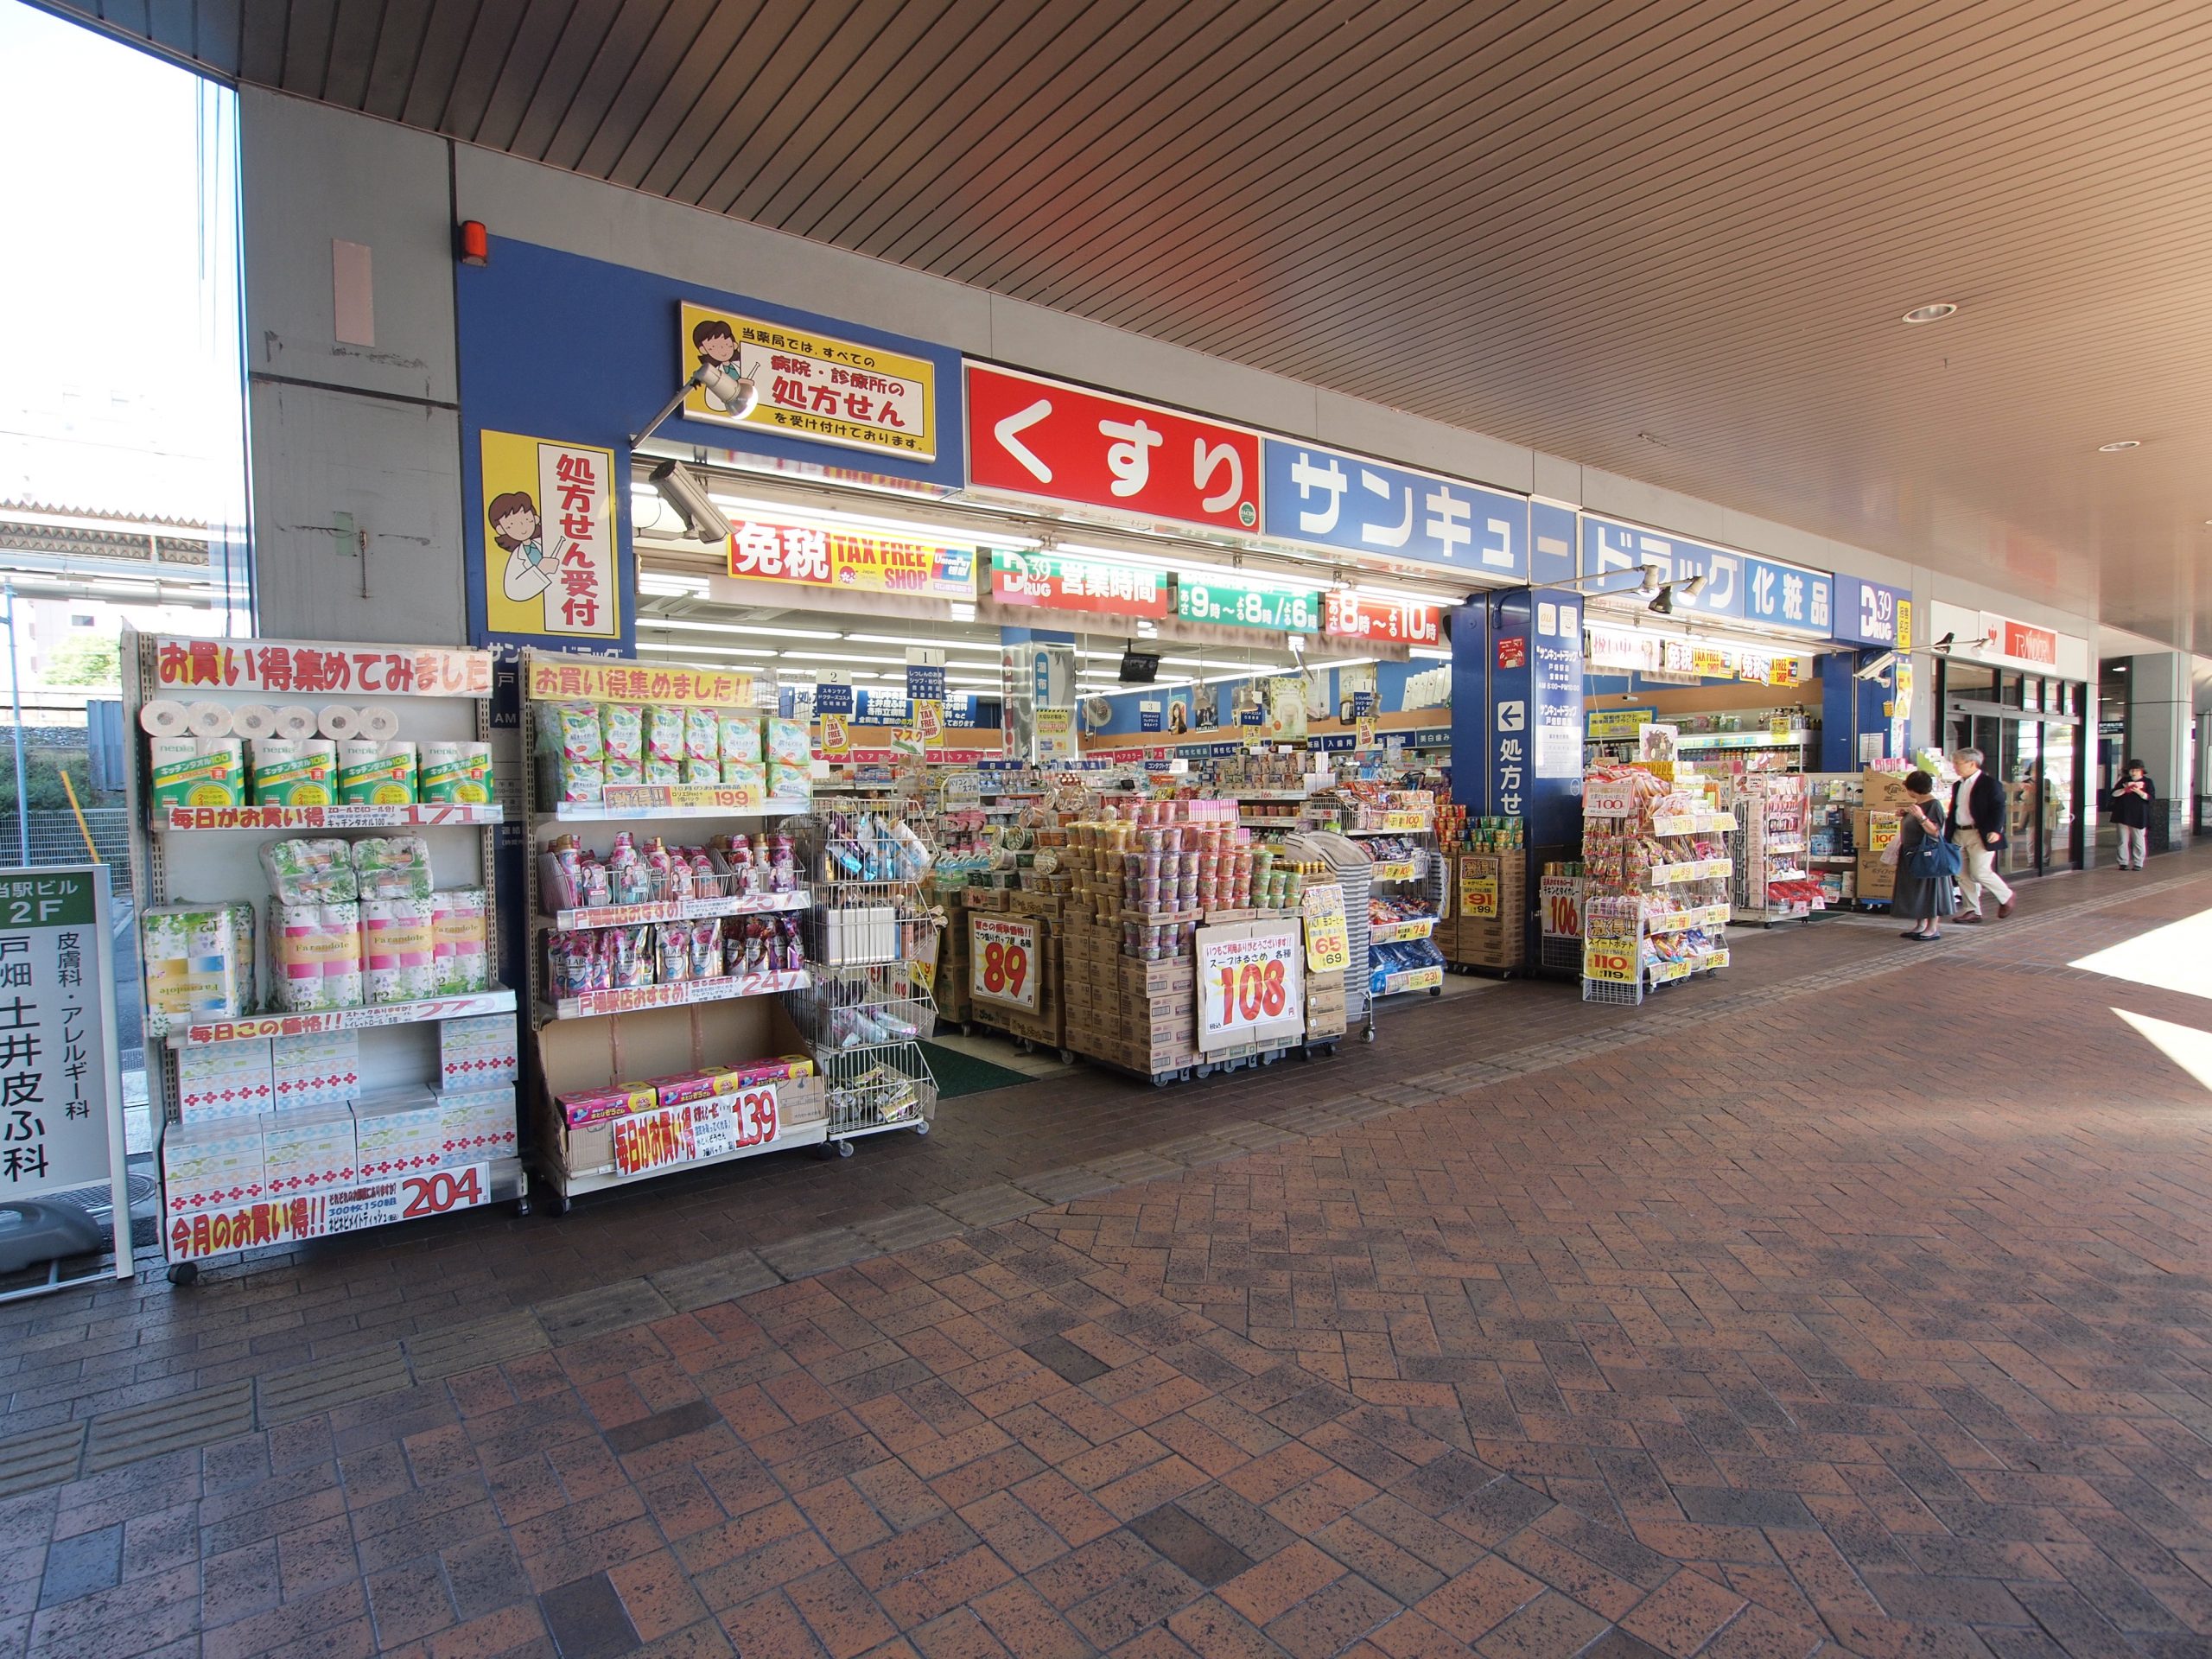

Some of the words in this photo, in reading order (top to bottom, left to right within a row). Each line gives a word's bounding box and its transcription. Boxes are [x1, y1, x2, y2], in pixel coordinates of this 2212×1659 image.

[771, 355, 906, 397] 病院・診療所の
[772, 376, 906, 428] 処方せん
[775, 413, 923, 452] を受け付けております。
[995, 399, 1243, 512] くすり
[556, 454, 599, 626] 処方せん受付
[734, 521, 830, 579] 免税
[833, 536, 876, 564] TAX
[880, 541, 927, 568] FREE
[884, 568, 928, 590] SHOP
[1060, 563, 1157, 603] 営業時間
[1752, 566, 1828, 626] 化粧品
[1877, 590, 1892, 622] 39
[160, 641, 488, 692] お買い得集めてみました
[923, 652, 927, 663] 1
[1668, 644, 1693, 671] 免税
[1694, 648, 1706, 661] TAX
[1706, 650, 1719, 663] FREE
[830, 672, 837, 683] 2
[1707, 663, 1719, 674] SHOP
[536, 666, 753, 703] お買い得集めました!!
[495, 714, 517, 723] AM
[920, 709, 933, 720] TAX
[920, 719, 935, 728] FREE
[828, 731, 841, 740] FREE
[828, 738, 843, 747] SHOP
[893, 728, 924, 743] マスク
[1179, 747, 1208, 756] 男性化粧品
[160, 754, 229, 776] キッチンタオル100
[264, 755, 327, 776] キッチンタオル100
[348, 756, 408, 775] キッチンタオル100
[715, 791, 749, 806] 199
[1596, 799, 1624, 810] 100
[171, 806, 325, 829] 毎日がお買い得
[400, 804, 480, 825] 171
[1405, 815, 1420, 825] 100
[1468, 893, 1492, 906] 91
[10, 899, 64, 923] 2F
[1551, 895, 1578, 936] 106
[374, 934, 425, 944] Farandole
[1413, 924, 1427, 934] 74
[296, 940, 349, 951] Farandole
[1020, 939, 1032, 948] 各種
[1206, 937, 1292, 957] いつもご利用ありがとうございます!!
[1315, 936, 1342, 955] 65
[1588, 938, 1634, 950] スイートポテト
[1210, 952, 1268, 969] スープはるさめ
[1275, 950, 1292, 961] 各種
[1326, 953, 1342, 964] 69
[1594, 954, 1628, 970] 110
[983, 941, 1027, 999] 89
[1603, 969, 1624, 979] 119
[741, 968, 800, 995] 247
[1221, 959, 1286, 1026] 108
[417, 998, 495, 1020] 279
[57, 931, 90, 1121] 皮膚科・アレルギー科
[189, 1013, 342, 1044] 毎日この価格!!
[680, 1090, 712, 1102] 水とりぞうさん
[591, 1108, 626, 1120] 水とりぞうさん
[733, 1090, 776, 1148] 139
[615, 1106, 696, 1176] 毎日がお買い得
[402, 1167, 482, 1219] 204
[328, 1197, 397, 1217] 300枚150組
[171, 1195, 326, 1259] 今月のお買い得!!
